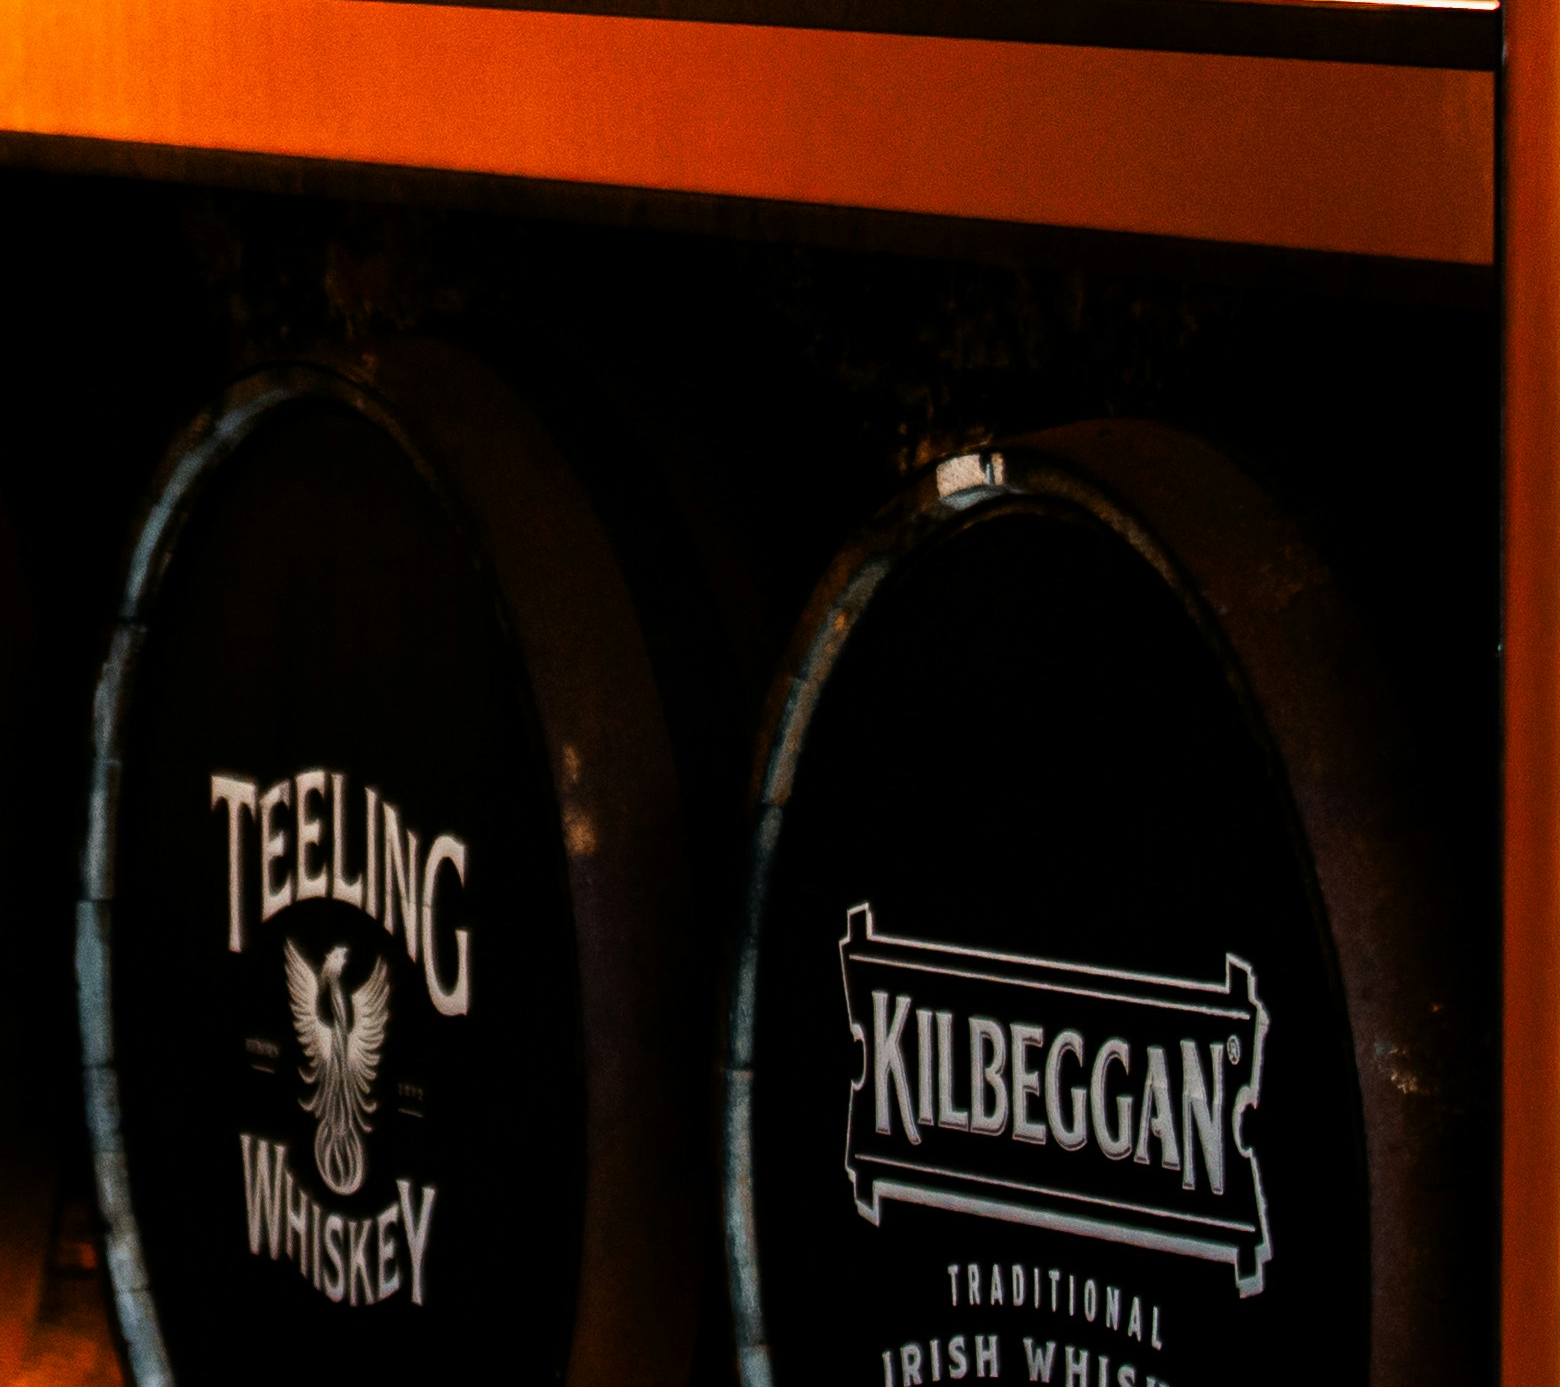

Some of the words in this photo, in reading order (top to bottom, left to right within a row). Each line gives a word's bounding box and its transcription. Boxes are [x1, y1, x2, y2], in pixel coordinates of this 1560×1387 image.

[210, 766, 475, 1018] TEELING
[239, 1132, 439, 1308] WHISKEY
[881, 1334, 1002, 1387] IRISH
[947, 1262, 1165, 1352] TRADITIONAL
